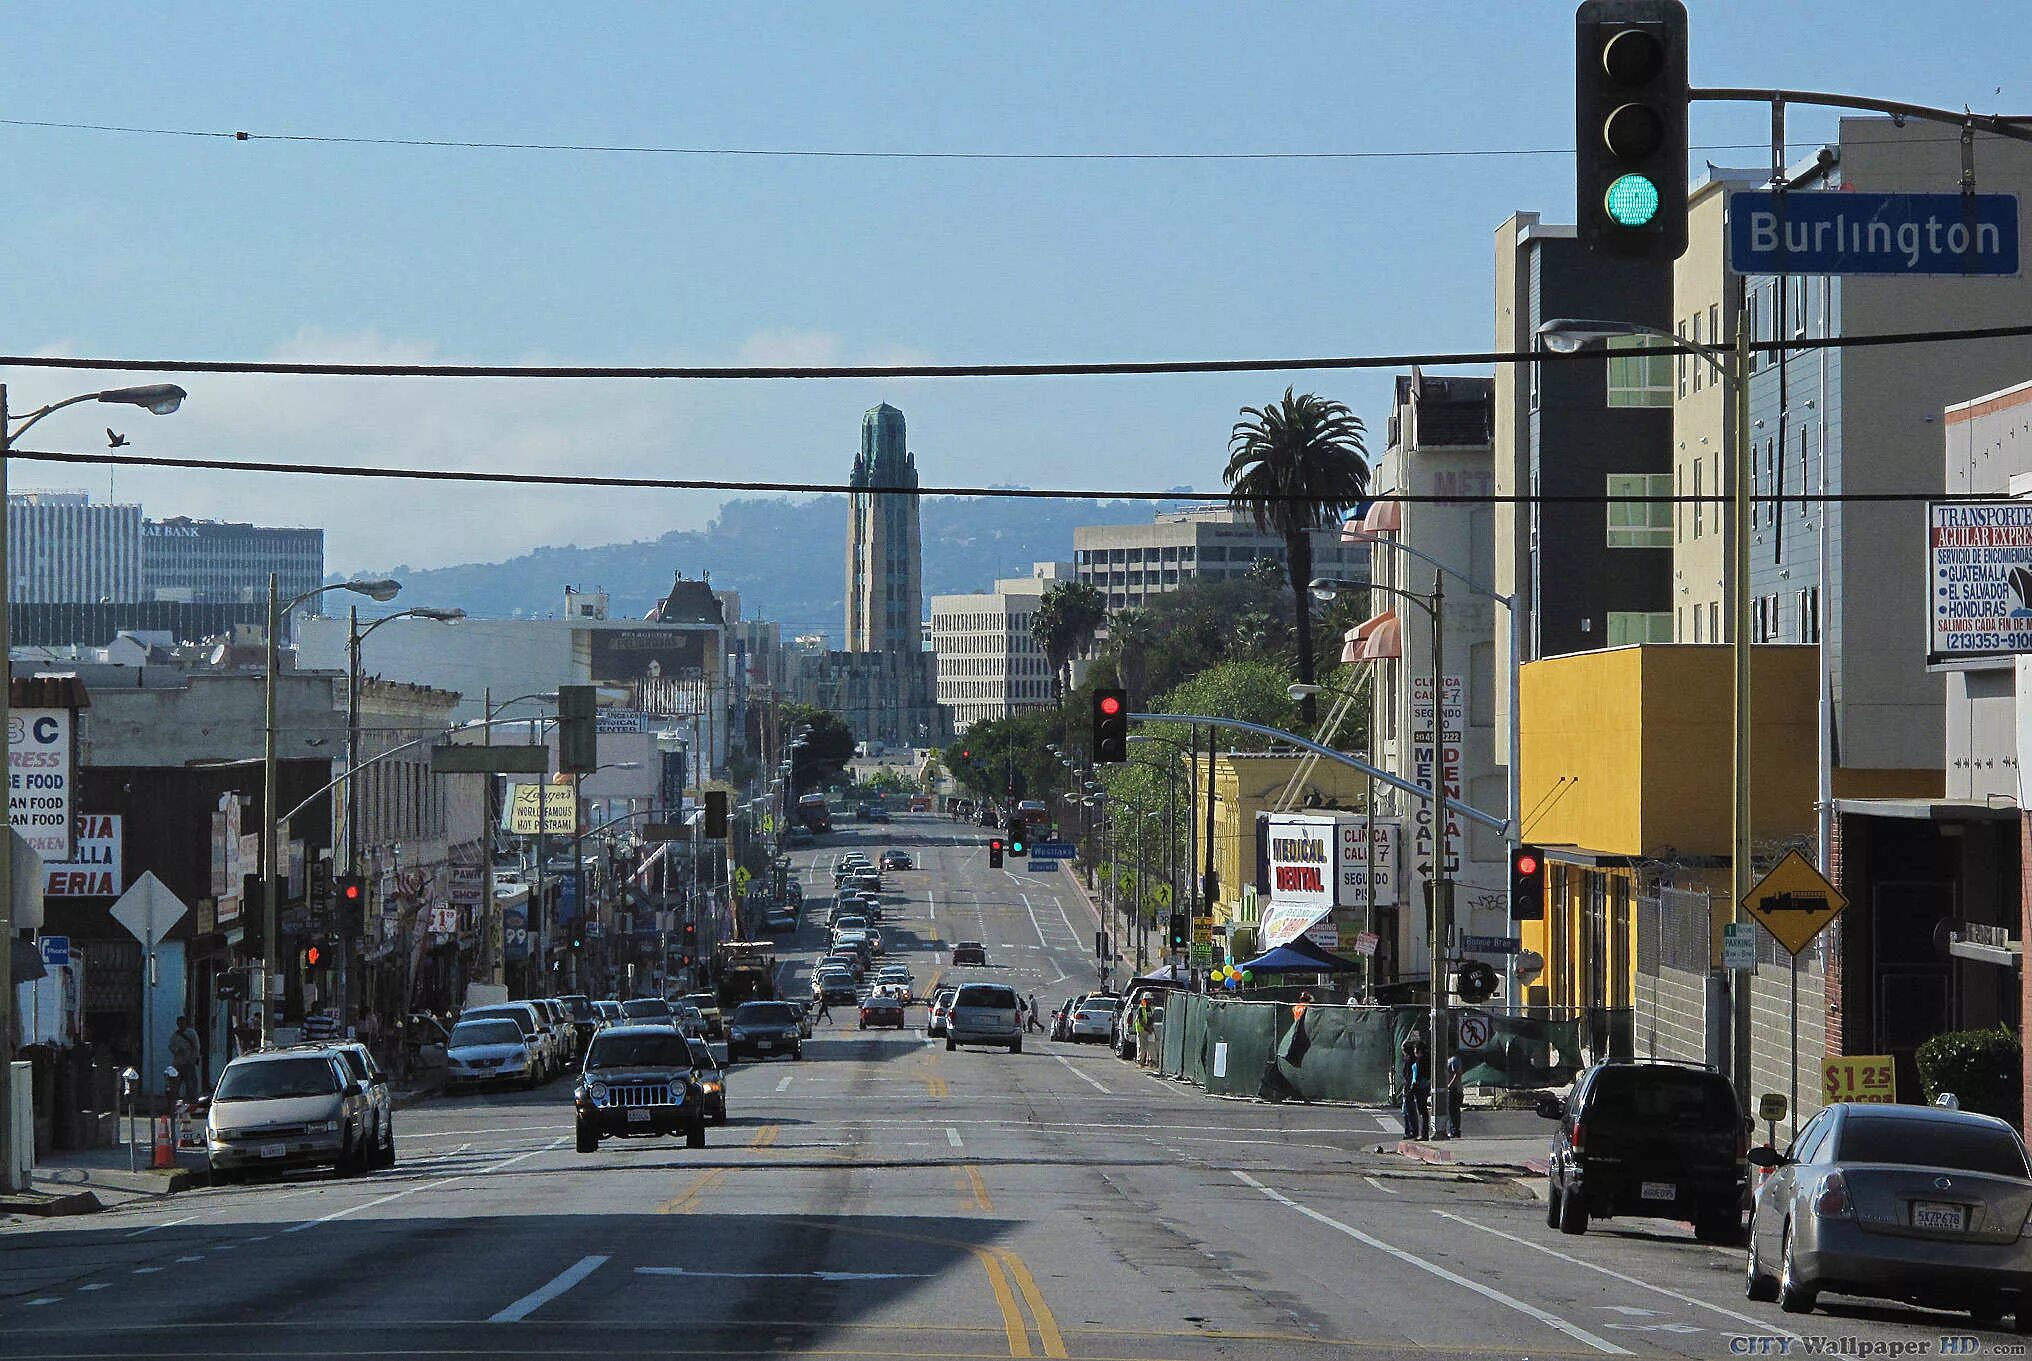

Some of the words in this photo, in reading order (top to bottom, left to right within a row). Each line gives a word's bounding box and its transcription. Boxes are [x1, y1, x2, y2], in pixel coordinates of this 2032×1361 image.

[1751, 212, 2000, 268] Burlington
[1939, 507, 2032, 527] TRANSPORTE
[164, 526, 200, 537] BANK
[1939, 527, 1990, 548] AGUILAR
[1938, 548, 1970, 565] SERVICIO
[1973, 548, 1982, 565] DE
[1948, 565, 2008, 583] GUATEMALA
[1948, 584, 1959, 600] EL
[1963, 582, 2009, 600] SALVADOR
[1948, 600, 2007, 618] HONDURAS
[1938, 618, 1973, 633] SALIMOS
[1975, 617, 1996, 632] CADA
[1999, 617, 2011, 632] FIN
[2014, 617, 2024, 631] DE
[1450, 688, 1461, 703] 7
[1414, 709, 1461, 718] SEGNDO
[33, 717, 59, 744] C
[1427, 720, 1450, 728] PO
[26, 774, 64, 789] FOOD
[30, 797, 64, 809] FOOD
[517, 787, 572, 803] Lager's
[544, 806, 572, 817] FAMOUS
[32, 814, 65, 826] FOOD
[517, 820, 532, 831] HOT
[535, 820, 572, 831] PSTRAMI
[1344, 830, 1388, 843] CLINCA
[1273, 838, 1327, 863] MEDICAL
[1344, 847, 1372, 860] CALL
[1377, 845, 1390, 862] 7
[47, 872, 114, 895] ERIA
[1276, 866, 1324, 893] DENTAL
[1344, 873, 1388, 886] SEGUDO
[452, 890, 480, 900] SHOP
[1355, 888, 1377, 901] PIS
